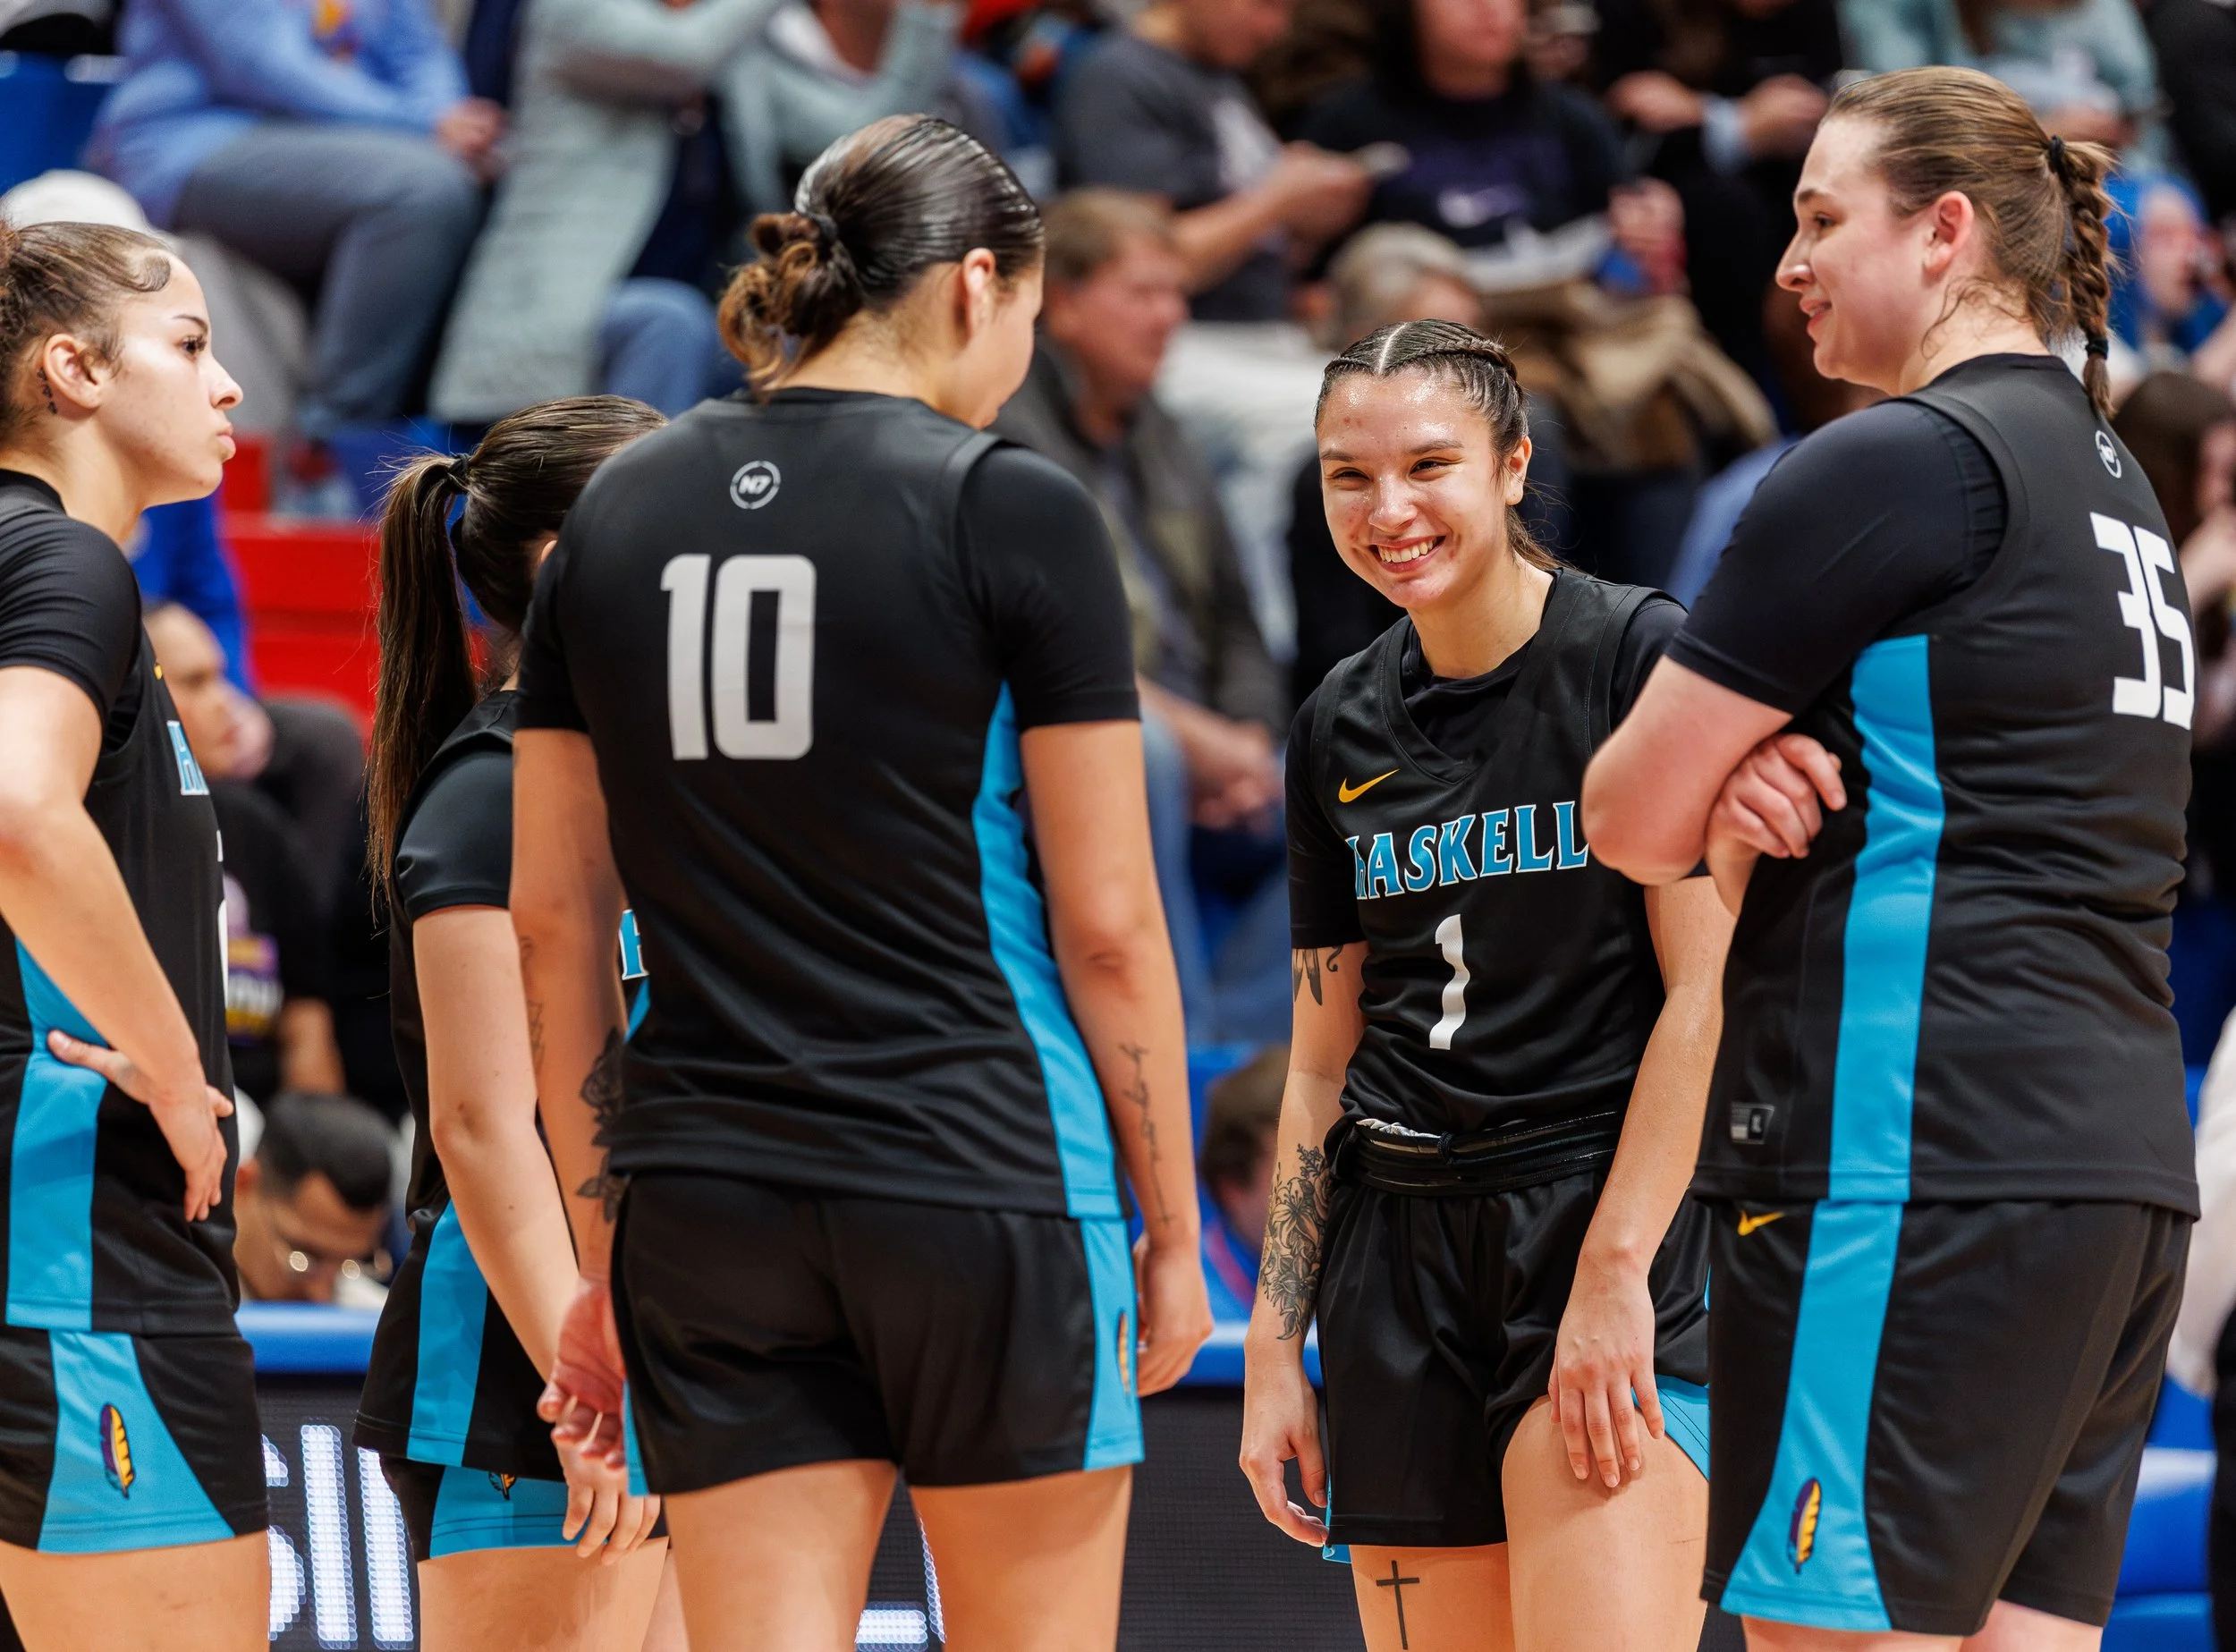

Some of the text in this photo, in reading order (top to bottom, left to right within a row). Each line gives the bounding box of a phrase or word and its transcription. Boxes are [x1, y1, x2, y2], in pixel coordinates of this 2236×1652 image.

[660, 553, 817, 760] 10
[2089, 511, 2195, 731] 35
[1429, 913, 1471, 1051] 1
